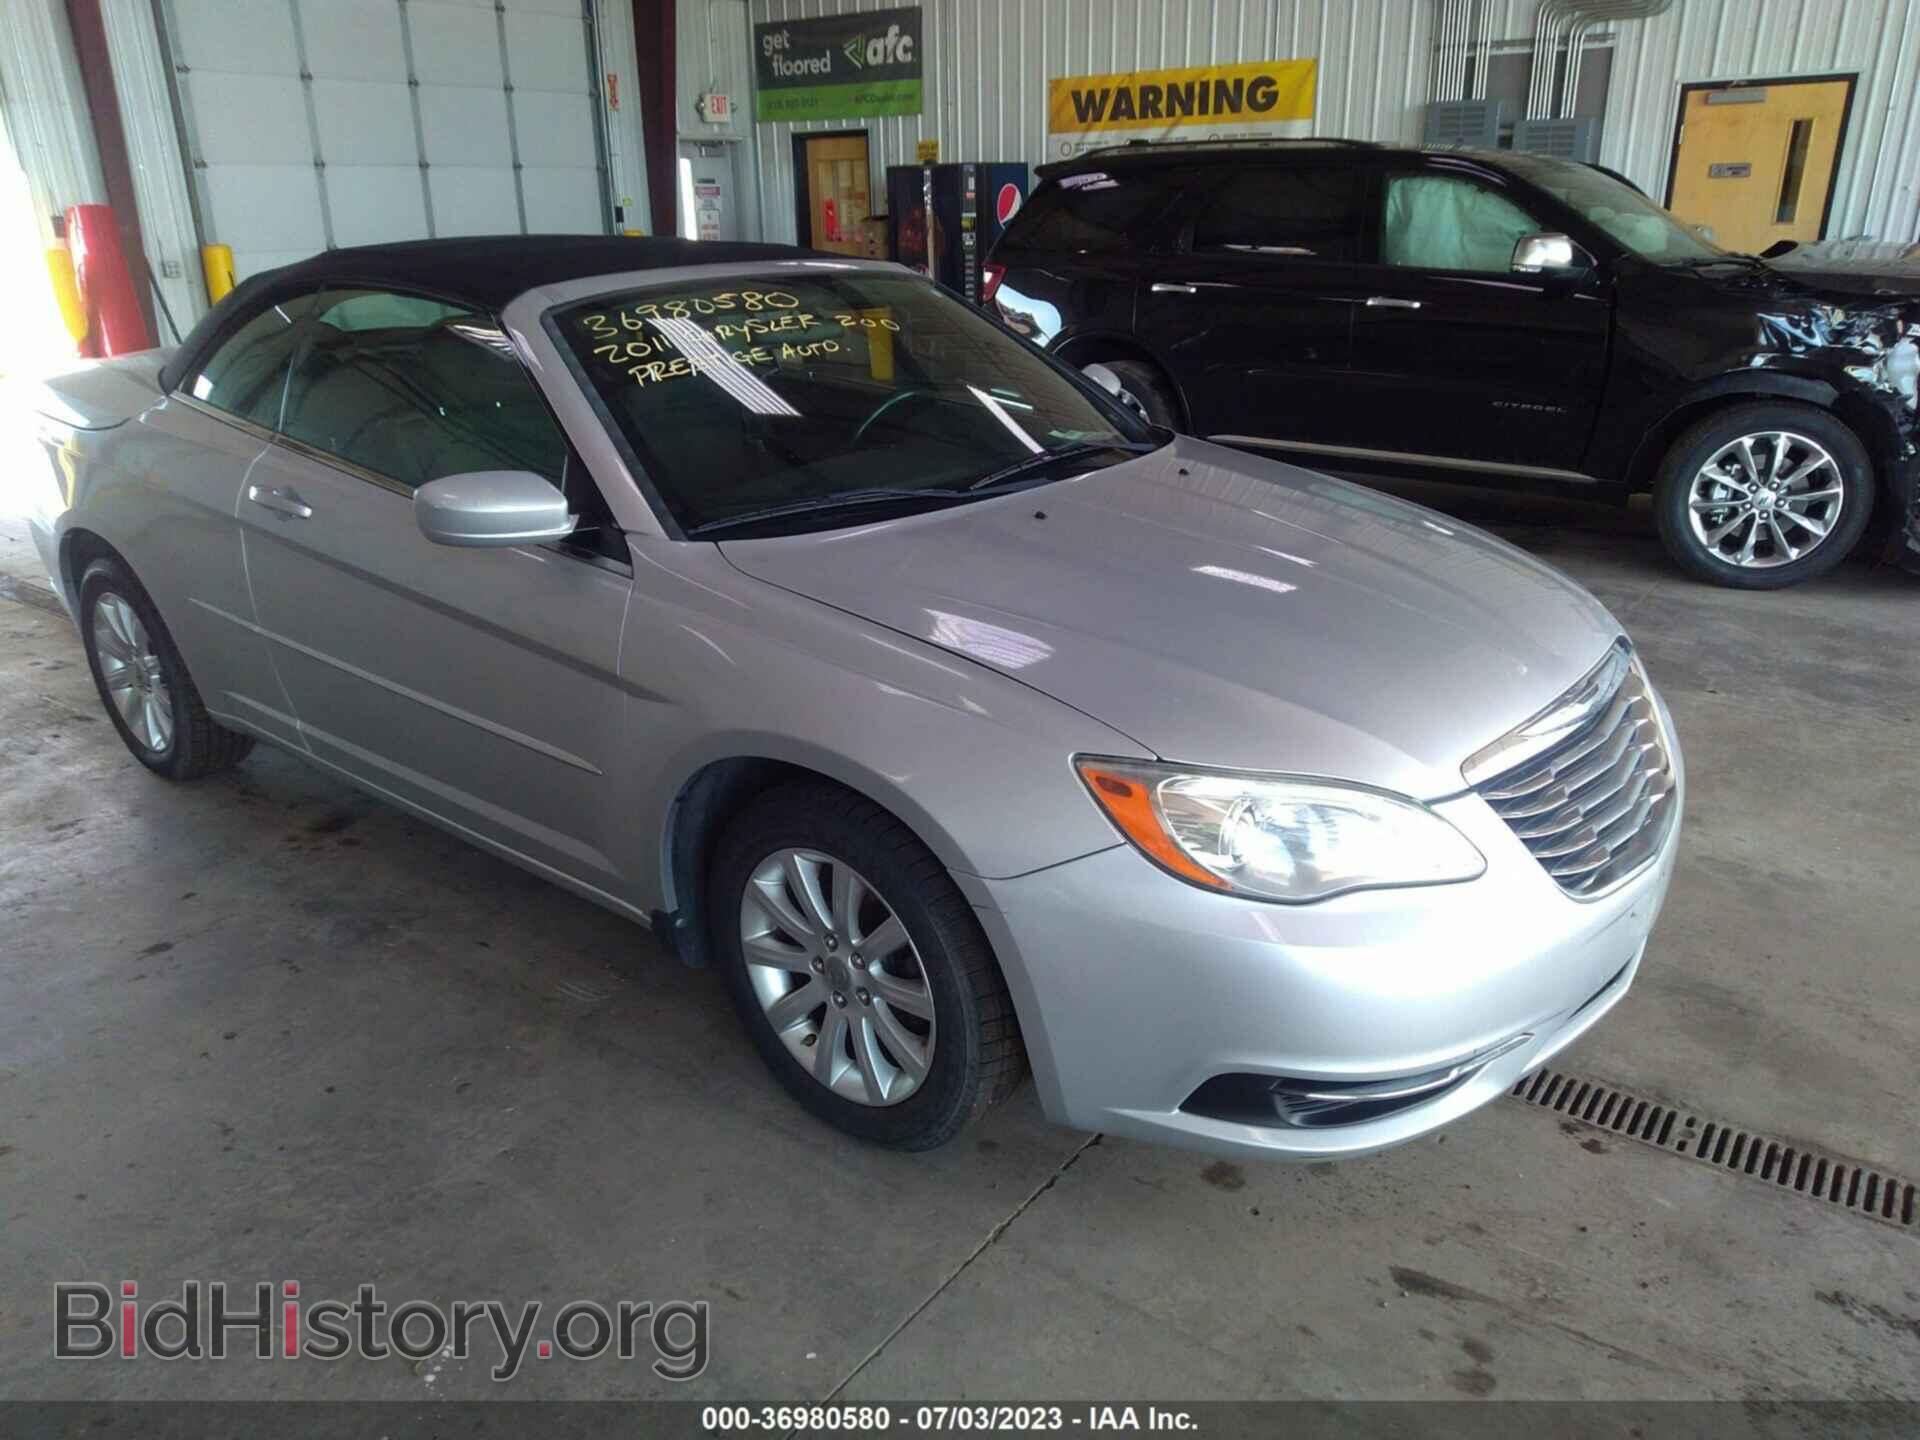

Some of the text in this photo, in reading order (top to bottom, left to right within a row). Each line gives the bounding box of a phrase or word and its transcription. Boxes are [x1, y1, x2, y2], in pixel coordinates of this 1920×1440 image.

[763, 30, 790, 56] get
[772, 50, 832, 77] floored
[866, 24, 914, 66] afc
[711, 95, 727, 114] EXIT
[1072, 75, 1279, 124] WARNING
[584, 291, 799, 339] 36980580
[593, 314, 900, 363] 2011 RYSLER 200
